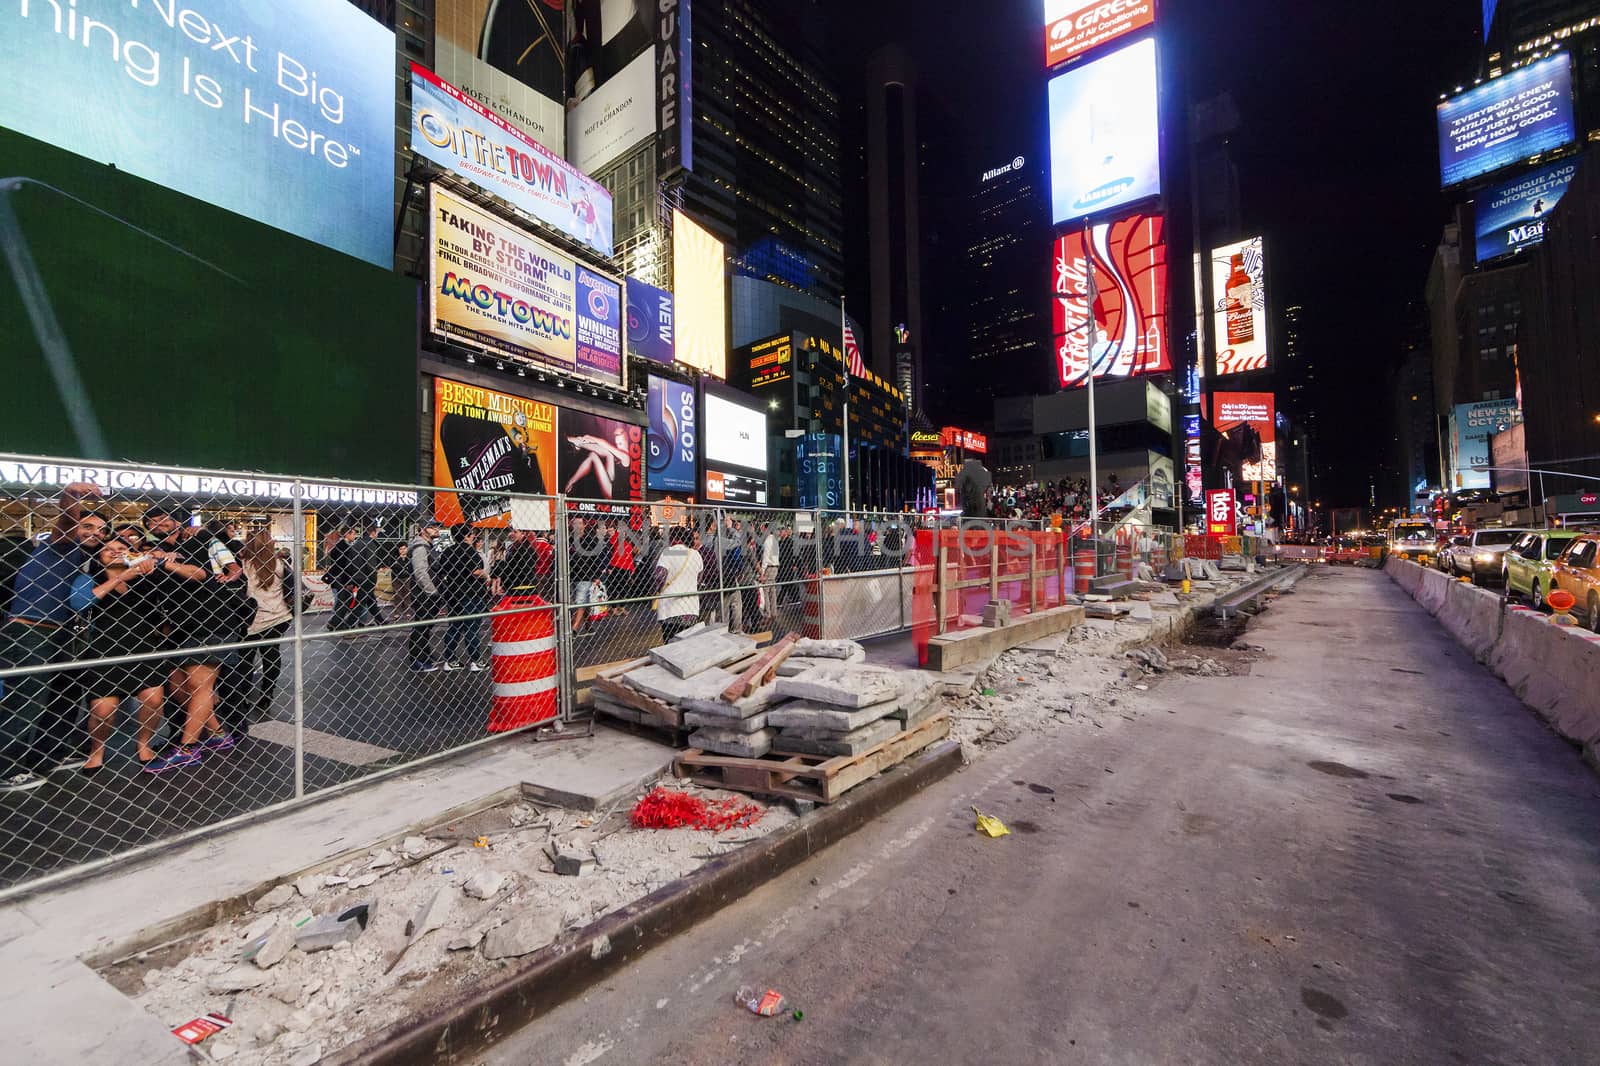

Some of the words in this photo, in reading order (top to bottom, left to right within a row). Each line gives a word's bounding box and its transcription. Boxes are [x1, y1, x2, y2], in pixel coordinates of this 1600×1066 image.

[1098, 4, 1149, 31] Conditioning
[183, 56, 223, 109] Is
[277, 51, 344, 125] Big
[1517, 80, 1553, 101] KNEW
[440, 81, 459, 98] NEW
[488, 110, 505, 127] NEW
[499, 104, 545, 133] CHANDON
[1449, 113, 1495, 138] MATILDA
[1495, 103, 1521, 119] WAS
[1455, 126, 1483, 143] THEY
[1484, 116, 1511, 133] JUST
[1455, 133, 1488, 153] KNOW
[1490, 123, 1518, 139] HOW
[504, 144, 570, 200] TOWN
[982, 163, 1012, 182] Allianz
[1548, 165, 1575, 182] AND
[438, 207, 496, 246] TAKING
[498, 237, 526, 260] THE
[528, 251, 572, 281] WORLD
[438, 238, 449, 248] ON
[451, 242, 469, 257] TOUR
[472, 237, 492, 257] BY
[495, 249, 548, 284] STORM!
[438, 249, 462, 266] FINAL
[463, 260, 503, 283] BROADWAY
[504, 278, 551, 304] PERFORMANCE
[578, 270, 619, 300] Avenue
[441, 271, 571, 341] MOTOWN
[587, 288, 610, 321] Q
[466, 304, 481, 315] THE
[482, 311, 507, 325] SMASH
[525, 327, 553, 341] MUSICAL
[578, 313, 619, 343] WINNER
[659, 295, 673, 346] NEW
[578, 333, 593, 346] BEST
[441, 381, 485, 409] BEST
[487, 392, 553, 423] MUSICAL!
[441, 402, 464, 417] 2014
[464, 406, 487, 421] TONY
[487, 410, 514, 425] AWARD
[527, 420, 553, 433] WINNER
[1467, 408, 1498, 419] NEW
[680, 391, 695, 448] SOLO
[455, 435, 512, 491] GENTLEMAN'S
[681, 448, 695, 463] 2
[198, 477, 282, 500] EAGLE
[289, 484, 418, 506] OUTFITTERS
[482, 473, 516, 492] GUIDE
[579, 502, 596, 512] ONE
[611, 505, 630, 515] ONLY
[1212, 491, 1232, 522] tkts
